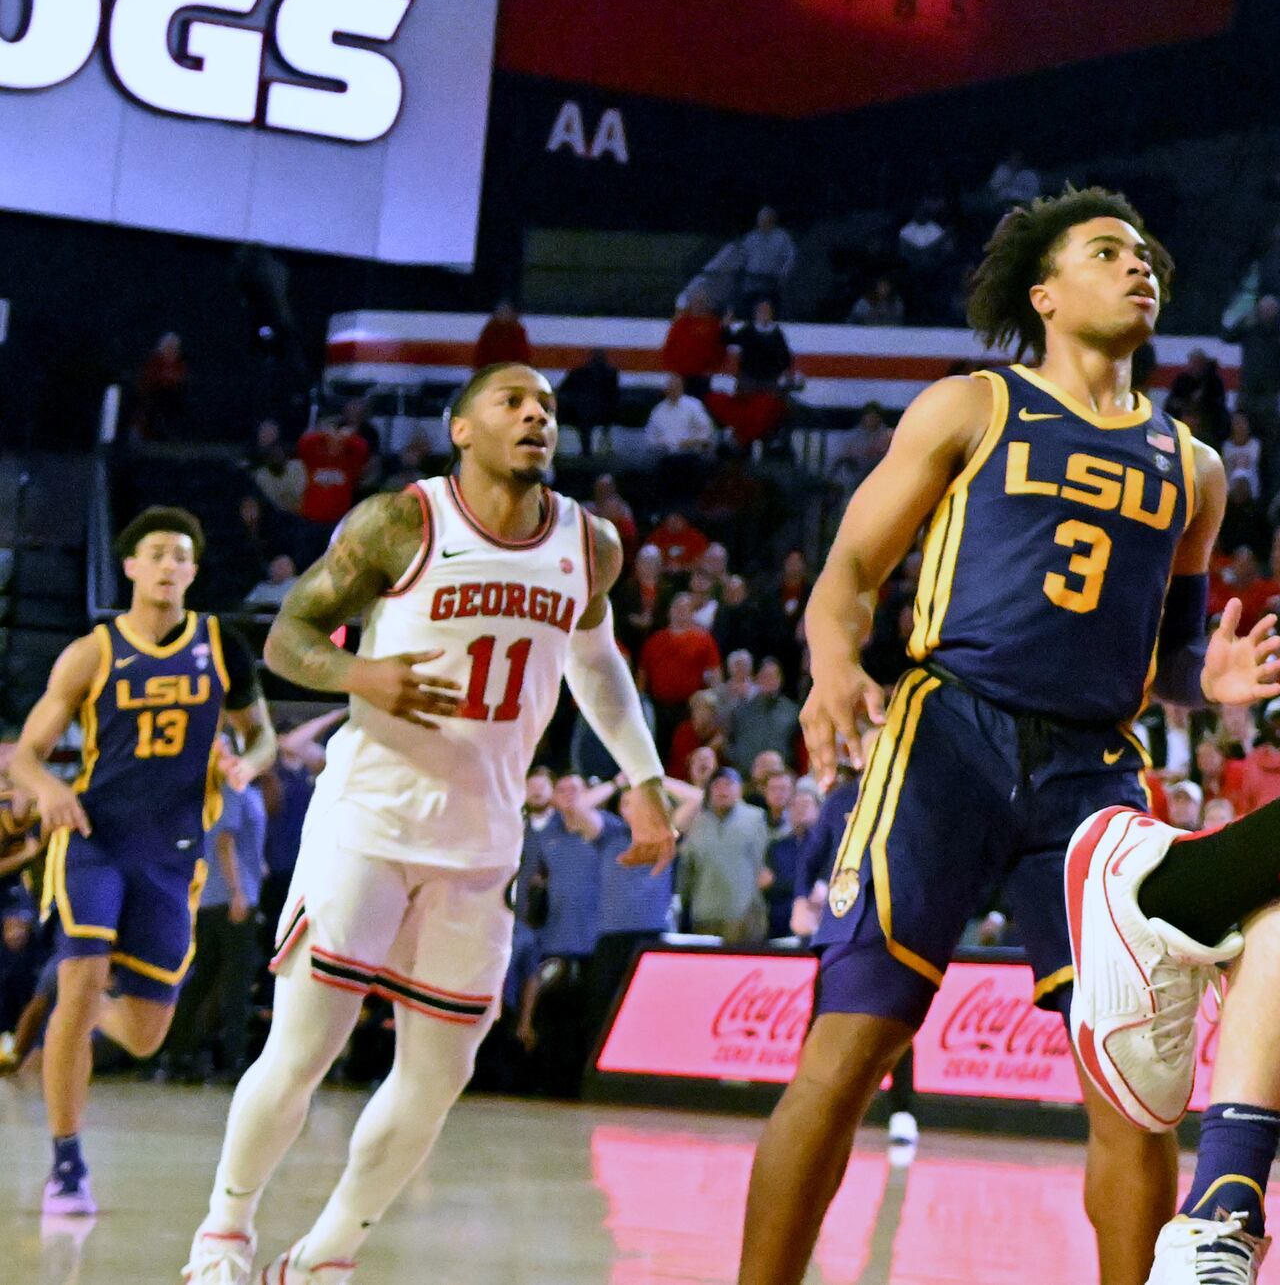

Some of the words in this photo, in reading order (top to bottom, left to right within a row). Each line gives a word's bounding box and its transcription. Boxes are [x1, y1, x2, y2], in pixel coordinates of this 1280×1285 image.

[546, 99, 629, 164] AA
[1004, 441, 1178, 531] LSU
[1043, 519, 1113, 614] 3
[115, 674, 211, 710] LSU
[462, 634, 532, 722] 11
[134, 708, 190, 759] 13
